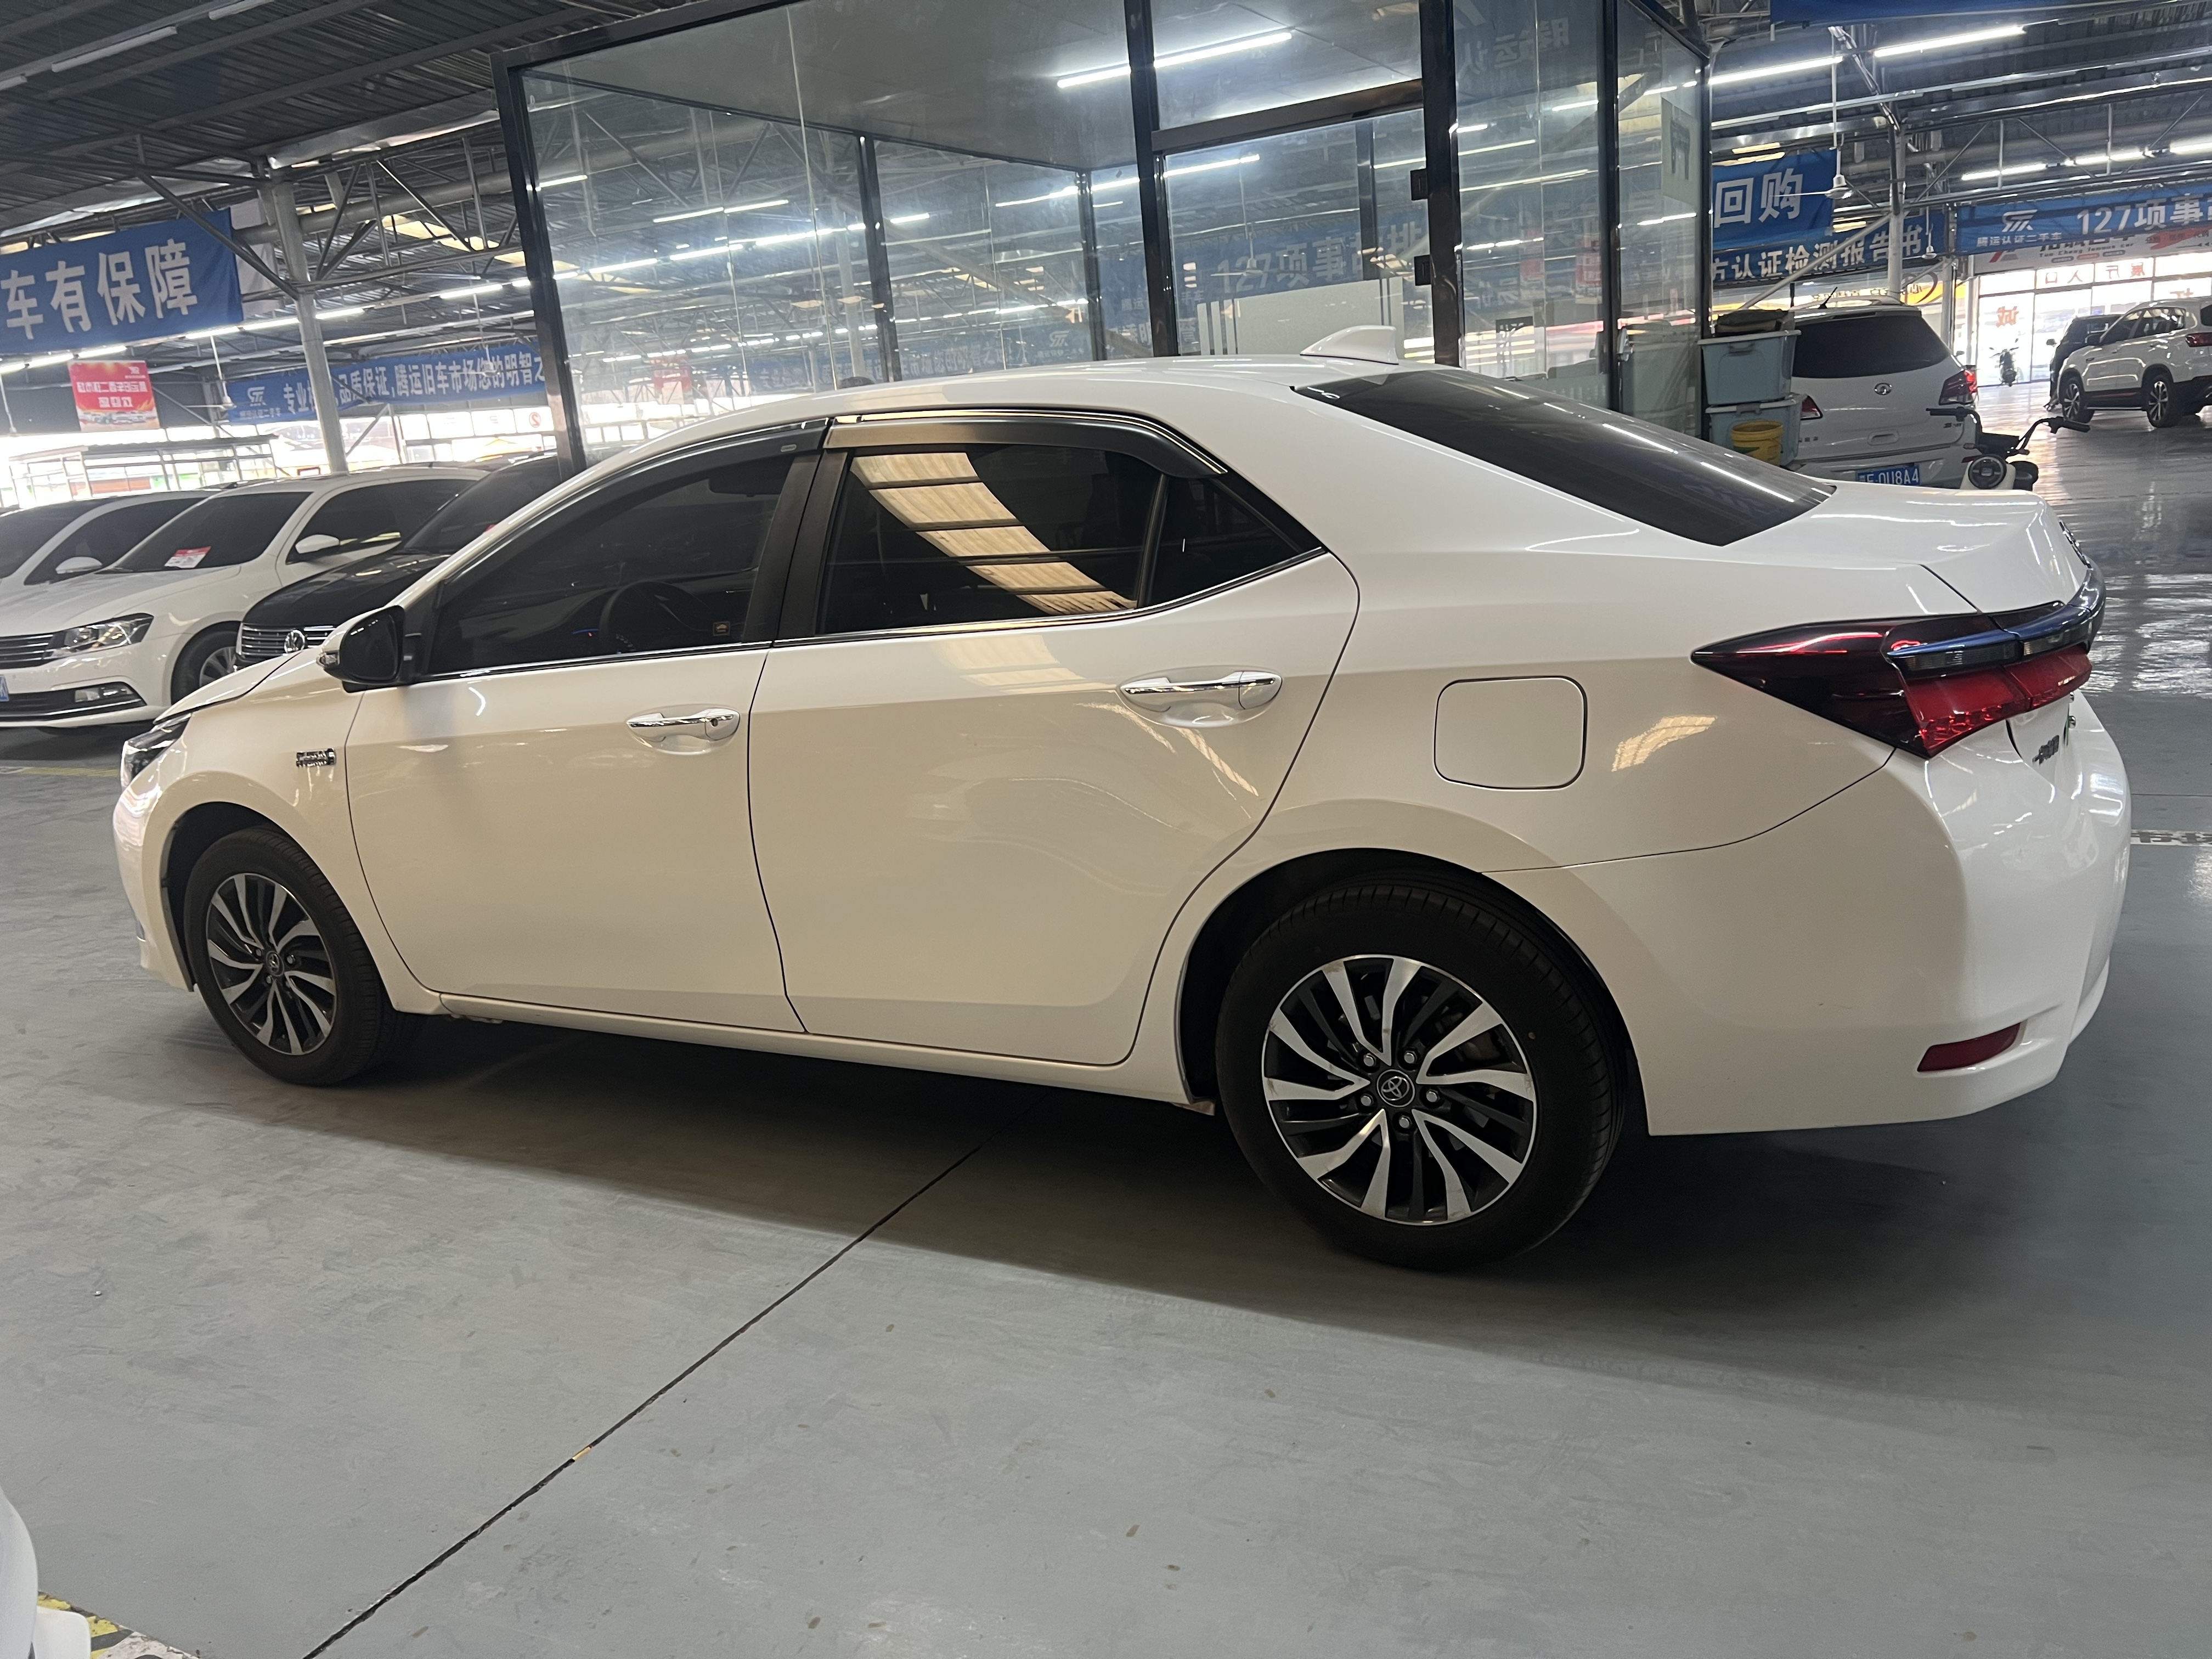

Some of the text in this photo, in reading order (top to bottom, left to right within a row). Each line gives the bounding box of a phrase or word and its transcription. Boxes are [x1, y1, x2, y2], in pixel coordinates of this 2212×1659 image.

[1713, 167, 1804, 228] 回购
[2077, 193, 2212, 235] 127项事
[1977, 232, 2063, 247] 腾运认证二手车
[1, 238, 198, 340] 车有保障
